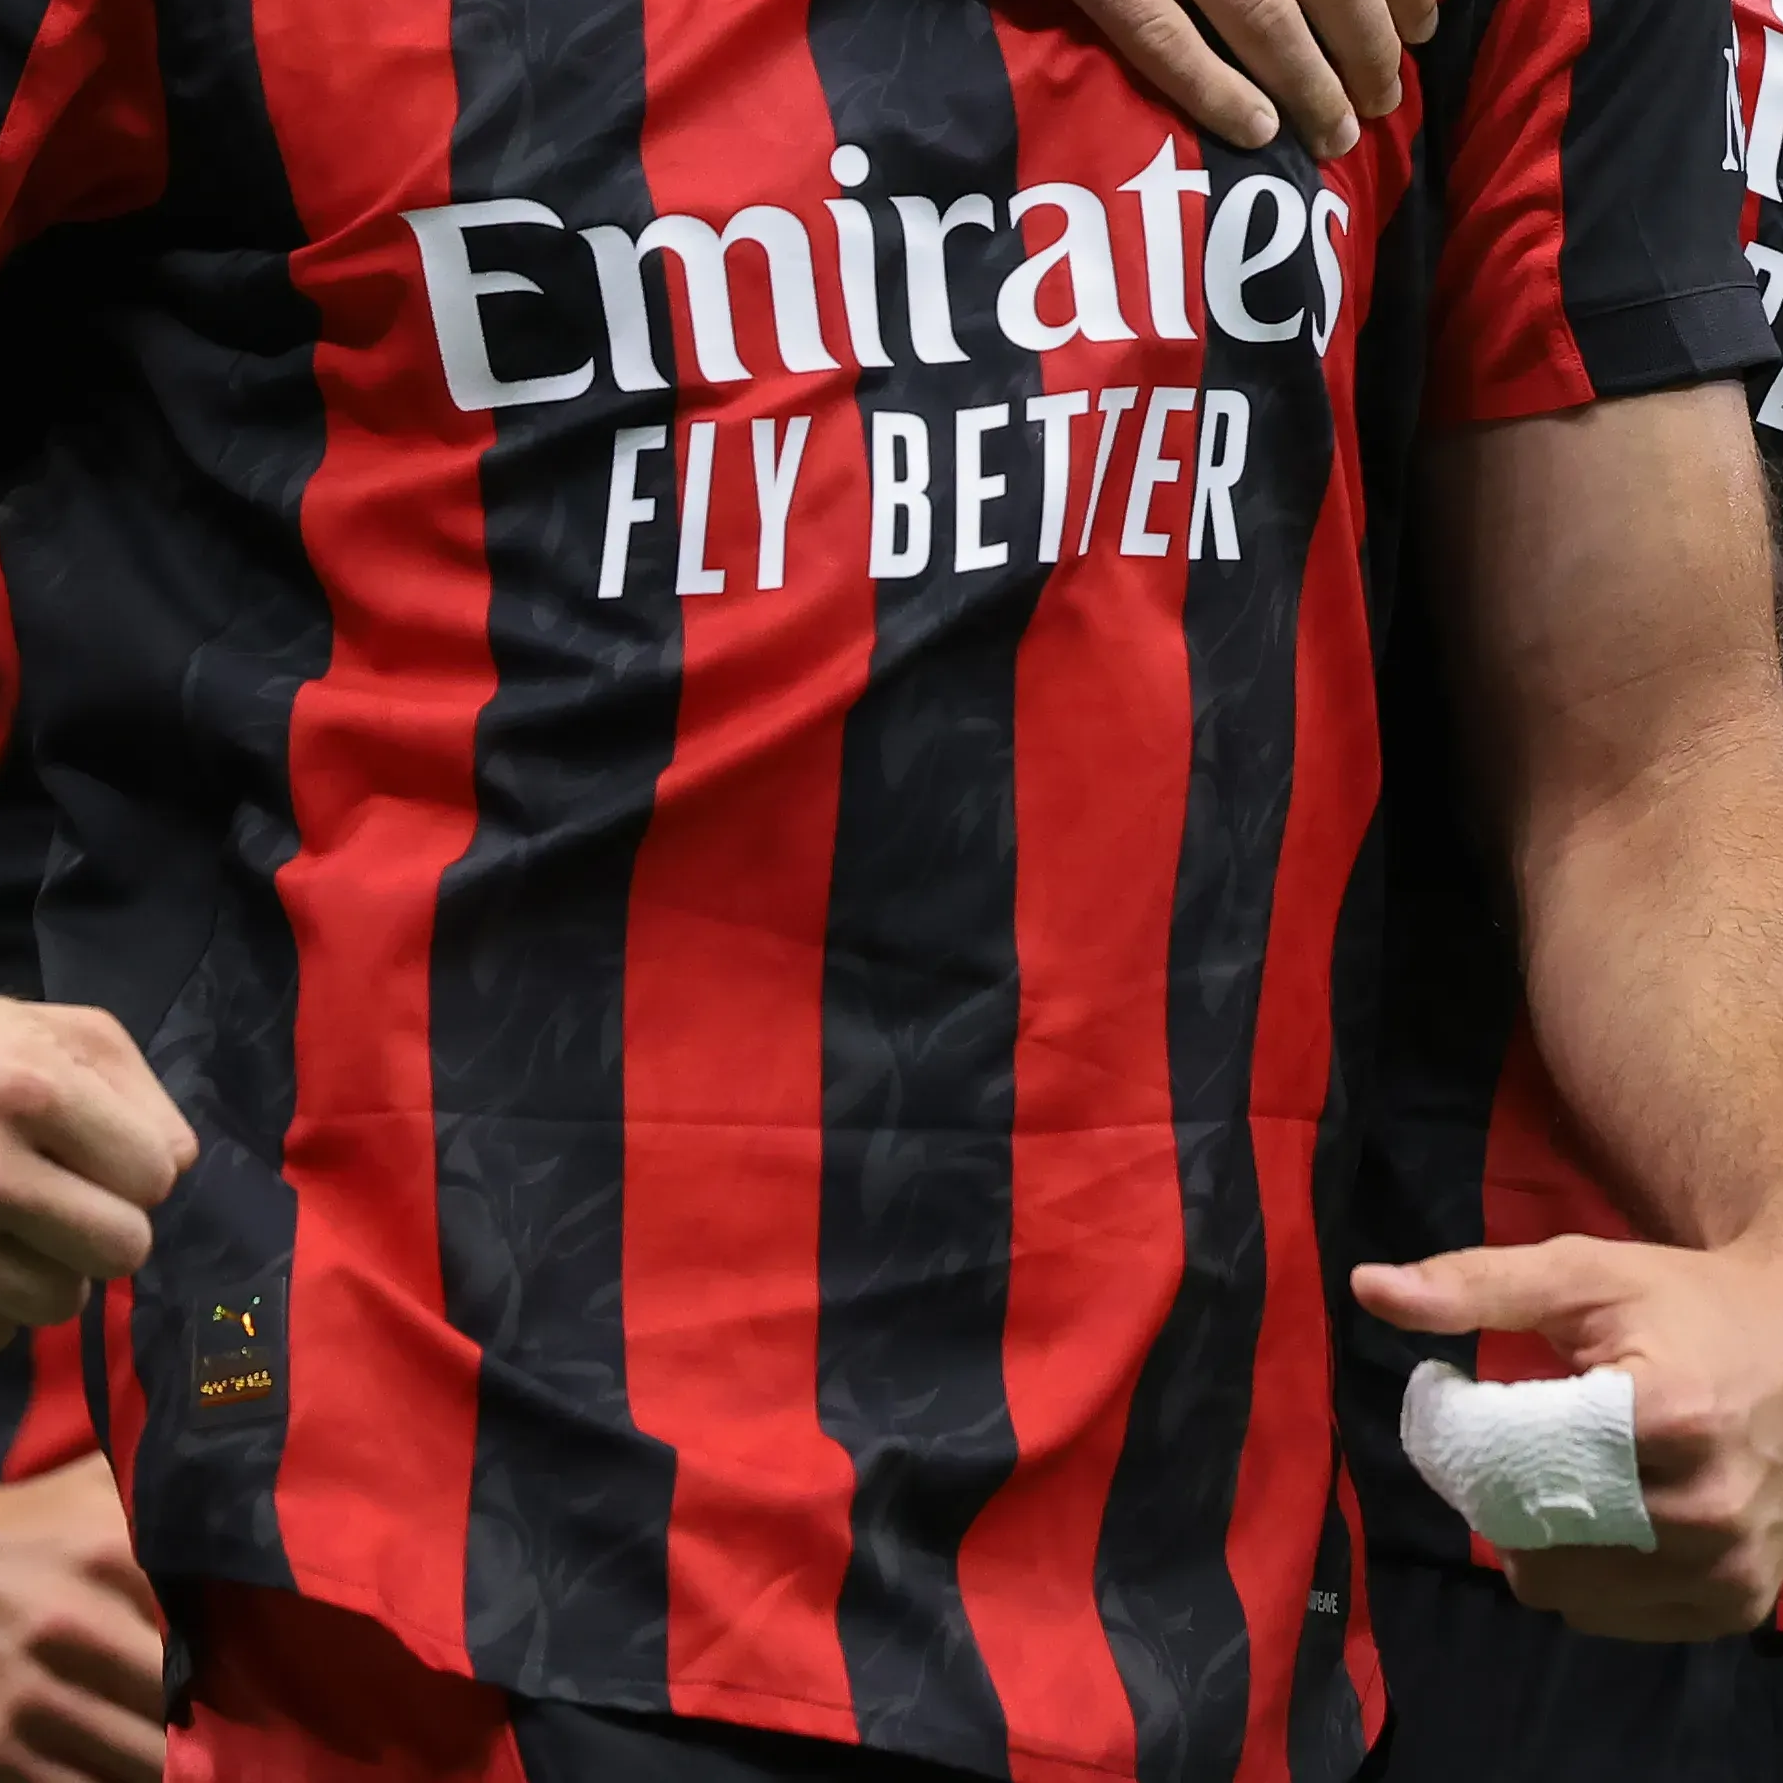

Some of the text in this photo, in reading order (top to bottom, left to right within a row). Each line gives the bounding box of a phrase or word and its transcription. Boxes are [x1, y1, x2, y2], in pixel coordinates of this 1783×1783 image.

[399, 132, 1350, 411] Emirates
[597, 386, 1252, 600] FLY BETTER
